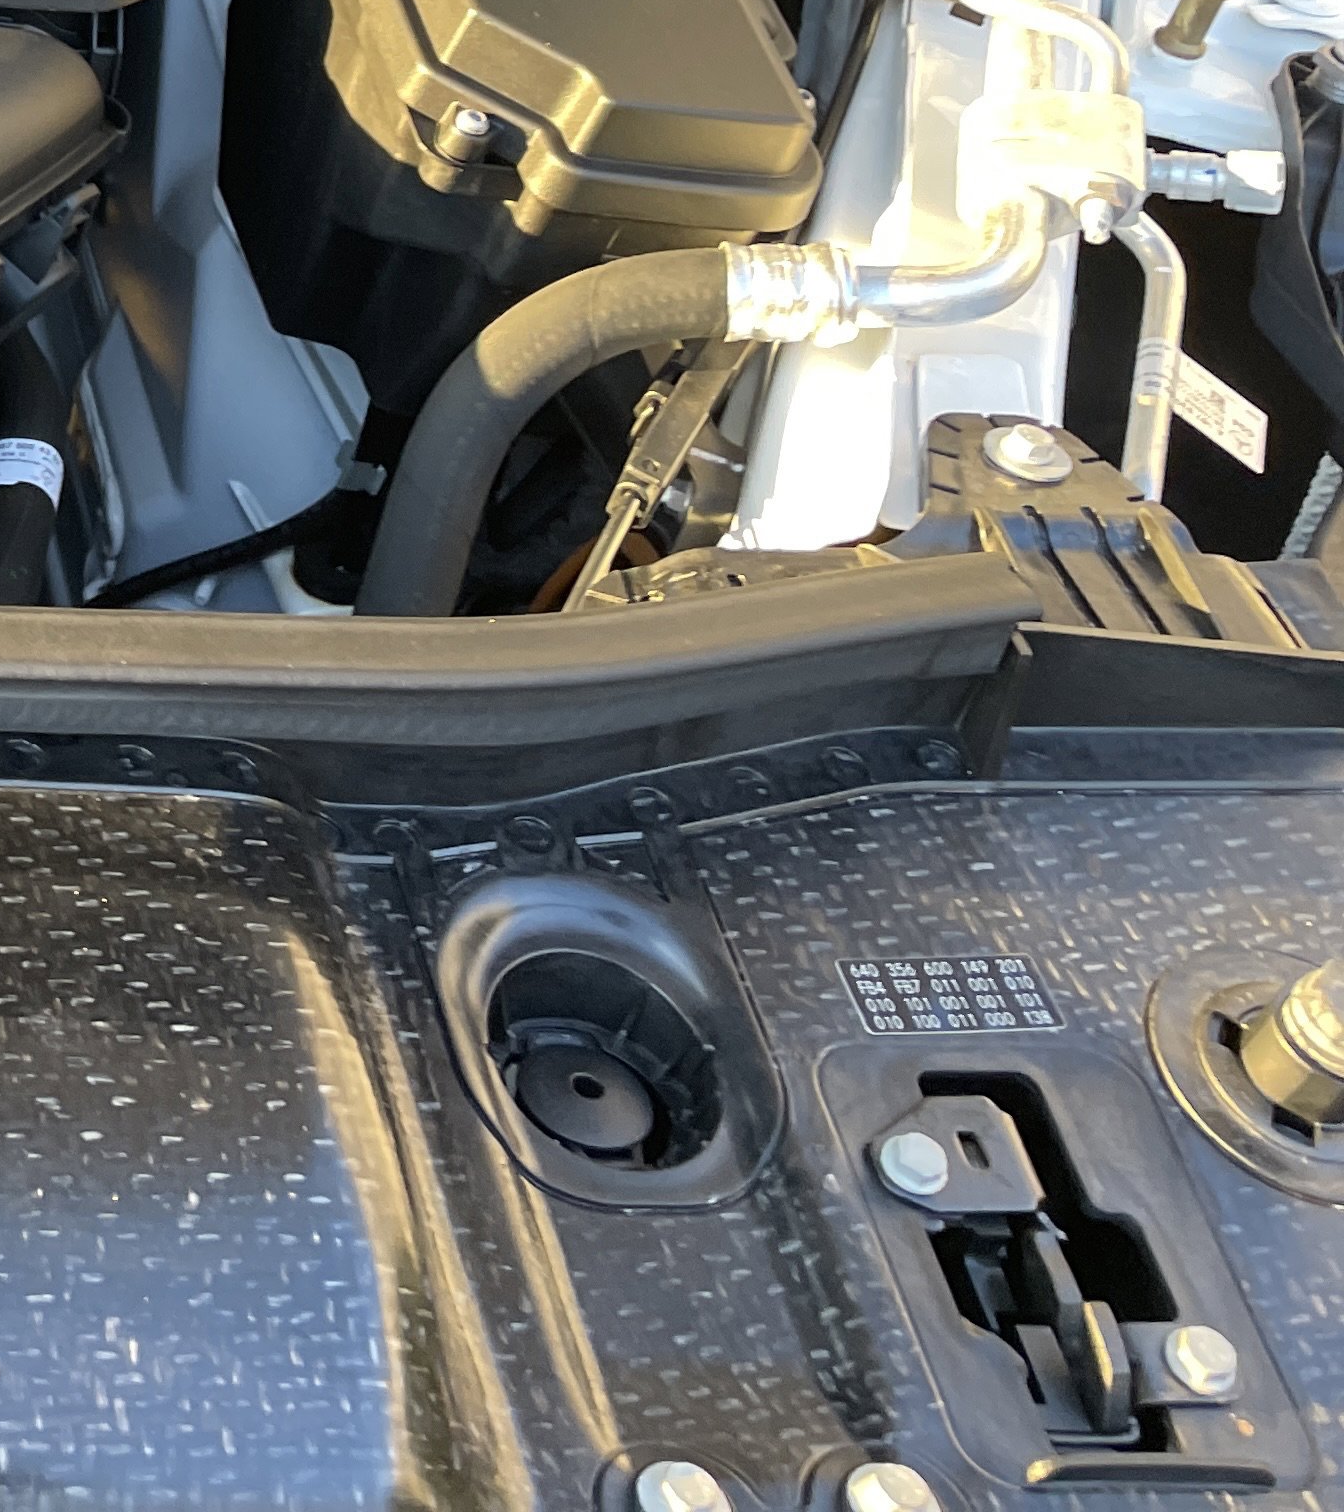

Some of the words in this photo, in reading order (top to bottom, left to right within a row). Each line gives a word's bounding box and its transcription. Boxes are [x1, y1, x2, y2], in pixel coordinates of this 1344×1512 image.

[850, 963, 879, 978] 640
[885, 963, 916, 977] 356
[924, 961, 954, 976] 600
[961, 960, 988, 974] 149
[994, 959, 1026, 973] 201
[856, 980, 886, 995] FB4
[893, 980, 920, 994] FB7
[930, 979, 961, 993] 011
[967, 978, 998, 991] 001
[1004, 976, 1035, 990] 010
[865, 998, 896, 1012] 010
[904, 997, 932, 1011] 101
[939, 996, 969, 1010] 001
[976, 995, 1007, 1009] 001
[1014, 993, 1044, 1007] 101
[873, 1015, 904, 1030] 010
[912, 1015, 941, 1029] 100
[947, 1014, 978, 1028] 011
[984, 1012, 1016, 1026] 000
